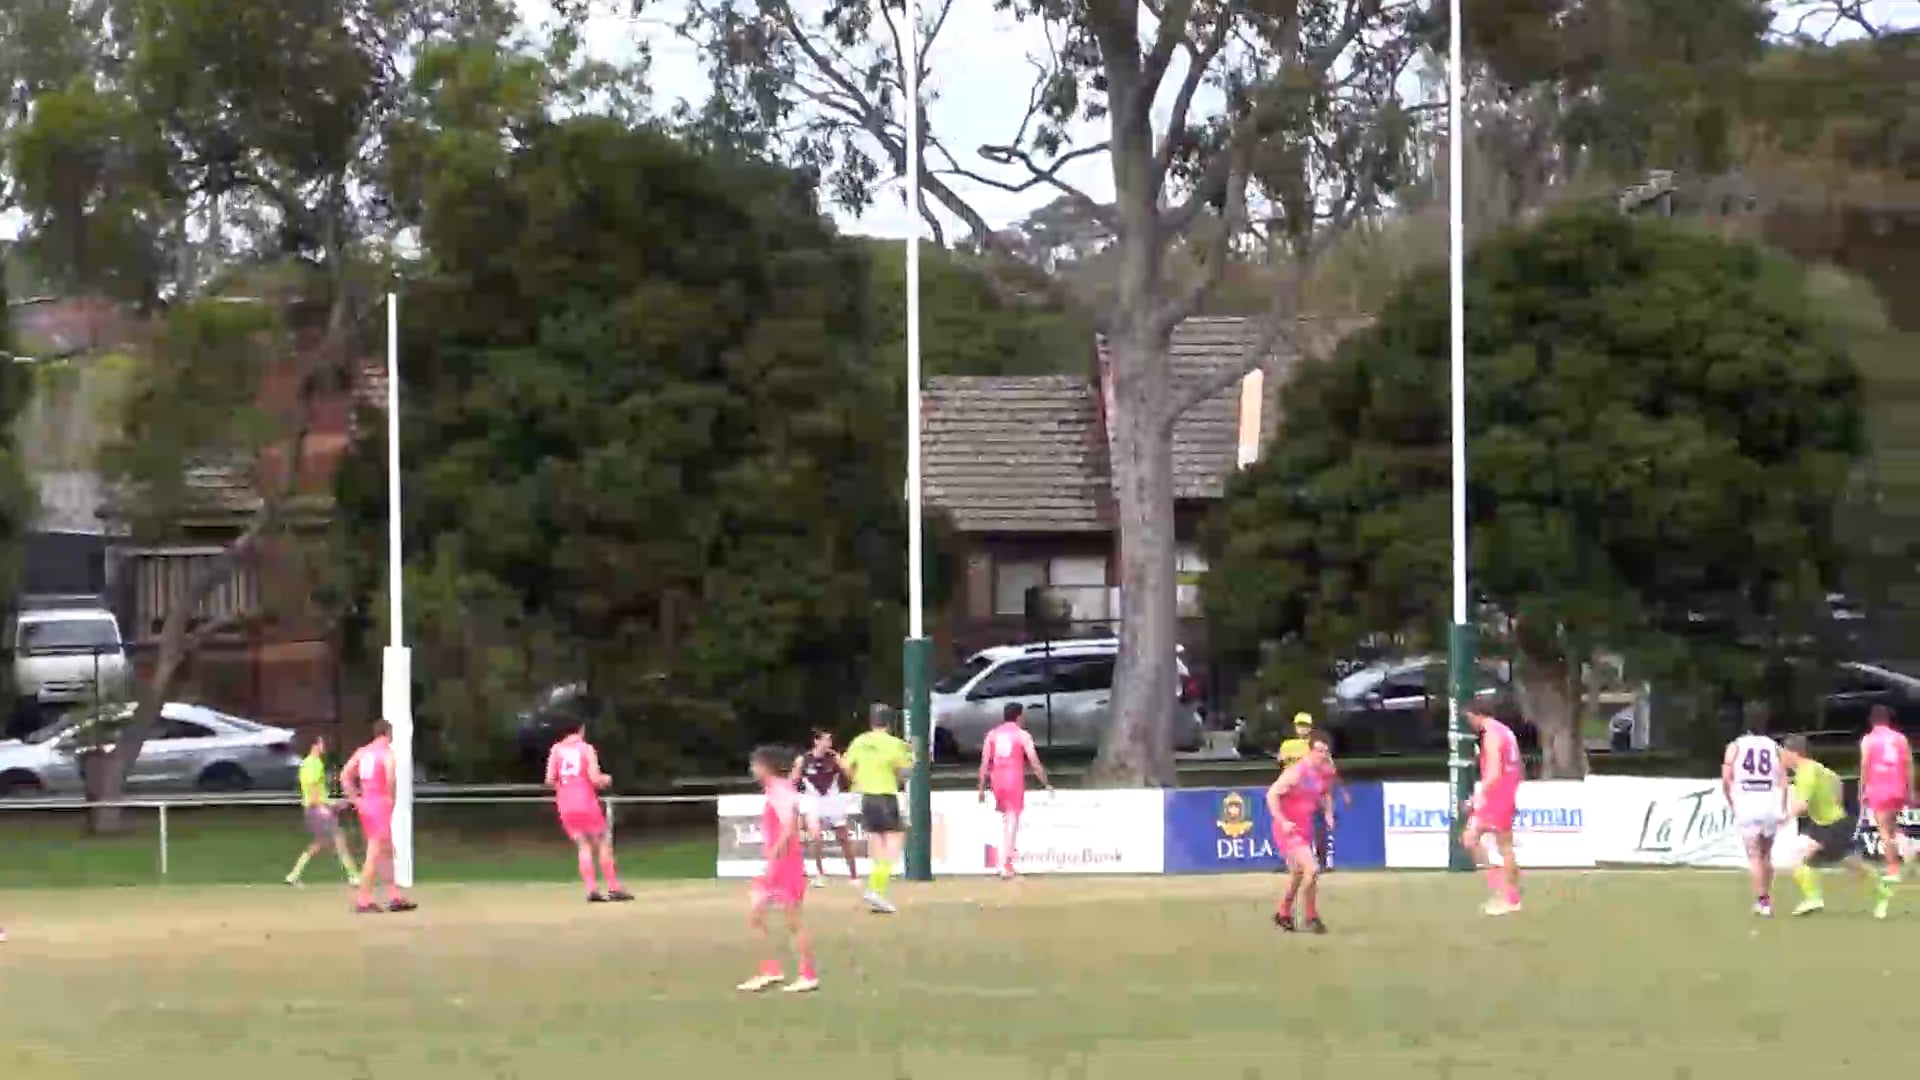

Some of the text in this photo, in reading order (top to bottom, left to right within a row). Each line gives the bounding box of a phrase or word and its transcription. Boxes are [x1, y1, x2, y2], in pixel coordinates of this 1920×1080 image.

[1742, 747, 1772, 776] 48
[1388, 803, 1450, 828] Harv
[1633, 800, 1673, 852] La
[1217, 838, 1273, 859] DE LA
